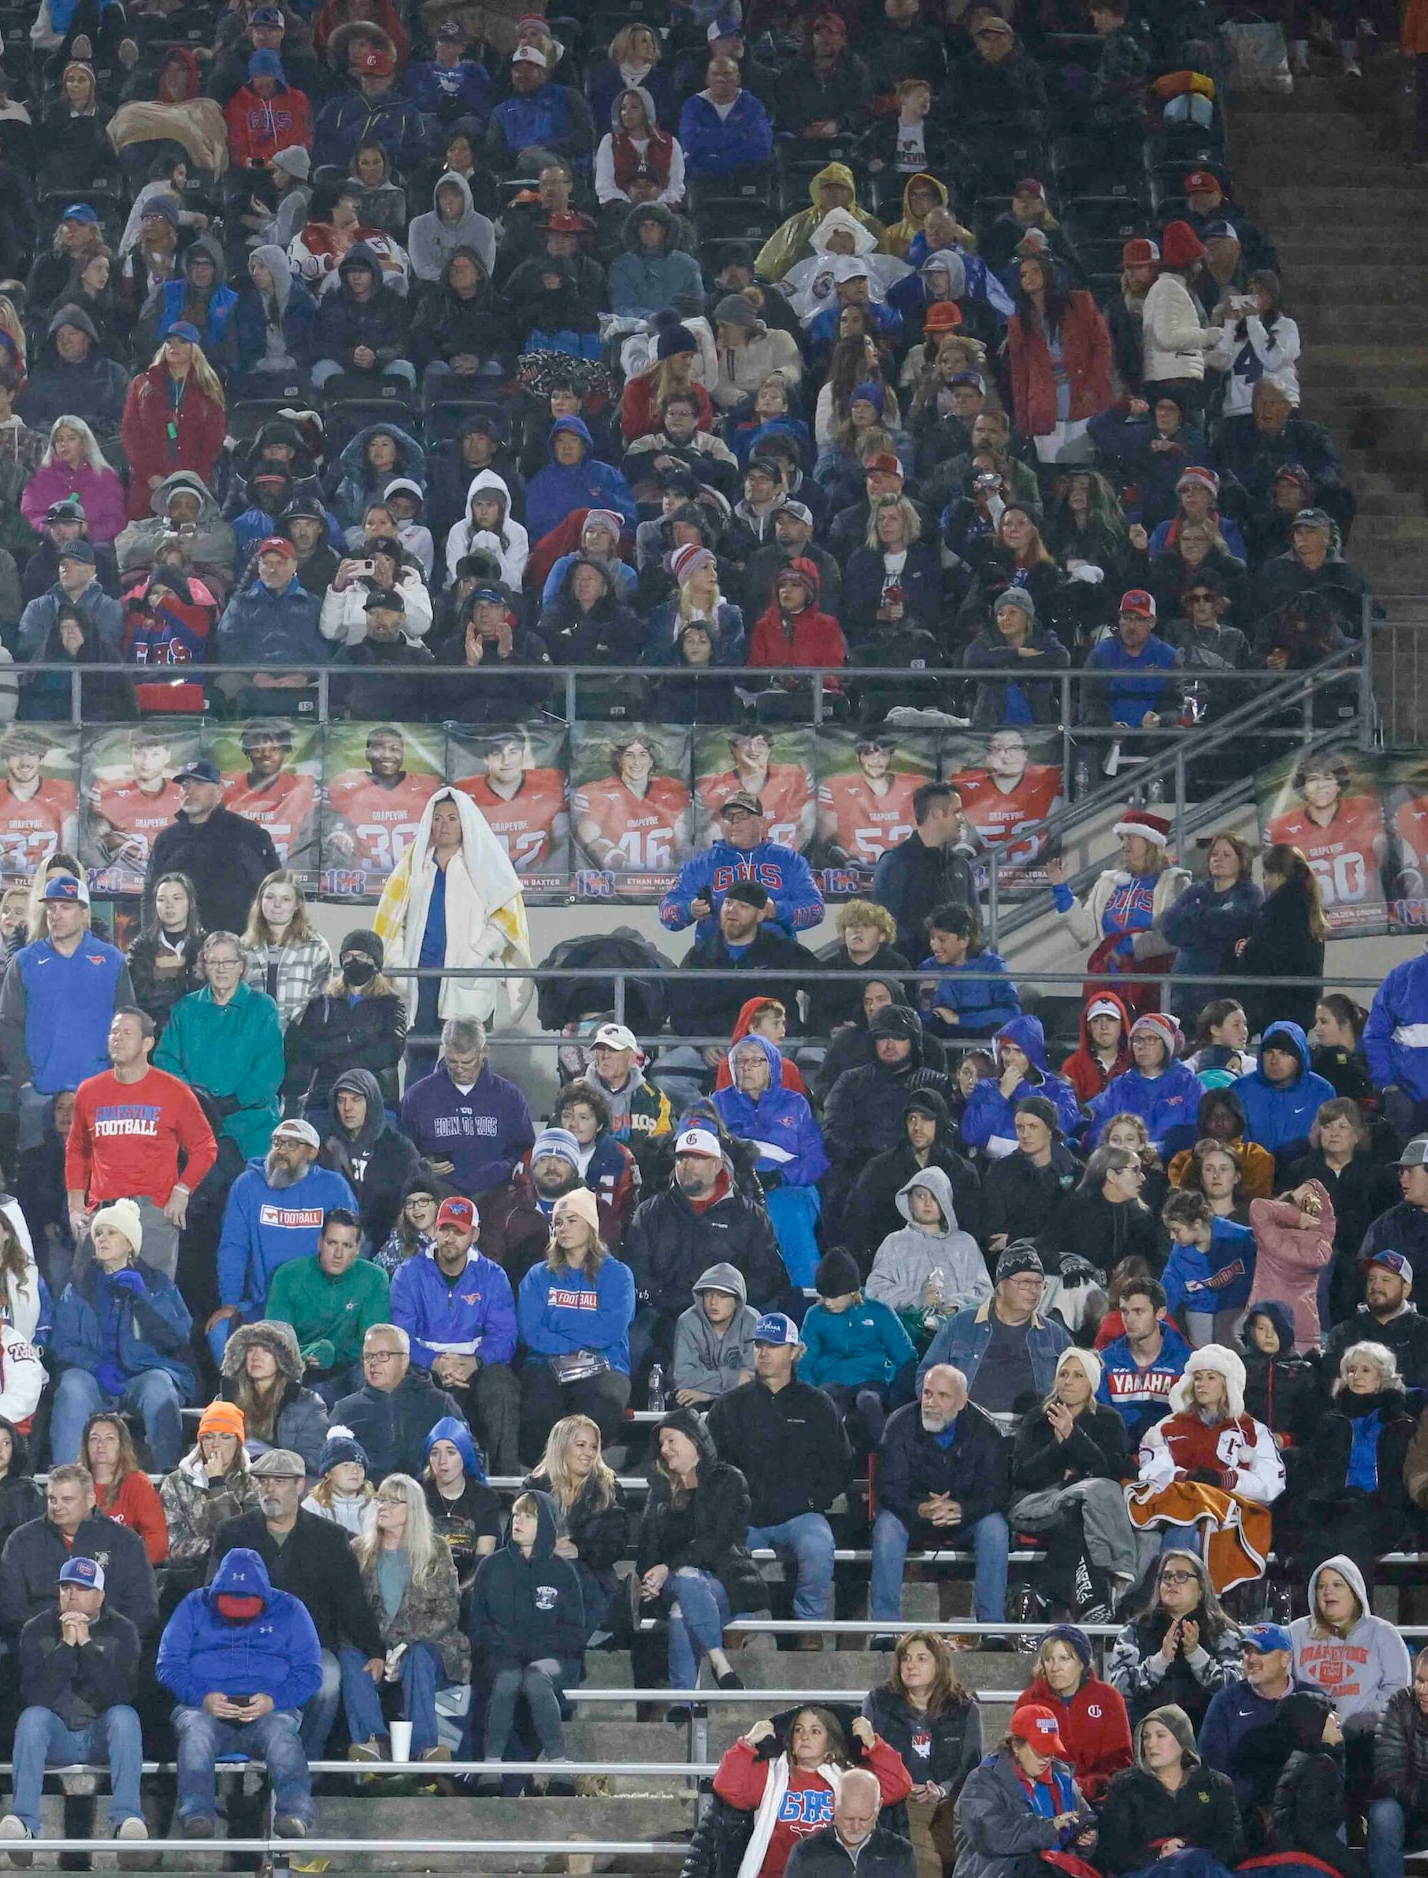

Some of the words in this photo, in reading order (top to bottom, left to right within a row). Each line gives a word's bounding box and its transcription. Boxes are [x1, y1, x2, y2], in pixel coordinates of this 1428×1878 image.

[9, 819, 44, 829] GRAPEVINE
[135, 816, 169, 828] GRAPEVINE
[372, 809, 408, 821] GRAPEVINE
[491, 820, 529, 833] GRAPEVINE
[617, 827, 674, 872] 46
[627, 878, 653, 886] ETHAN
[712, 864, 783, 893] GHS
[94, 1105, 161, 1123] GRAPEVINE
[94, 1118, 158, 1137] FOOTBALL
[278, 1207, 321, 1225] FOOTBALL
[558, 1291, 598, 1308] FOOTBALL
[1112, 1373, 1175, 1394] YAMAHA
[778, 1789, 837, 1824] GHS
